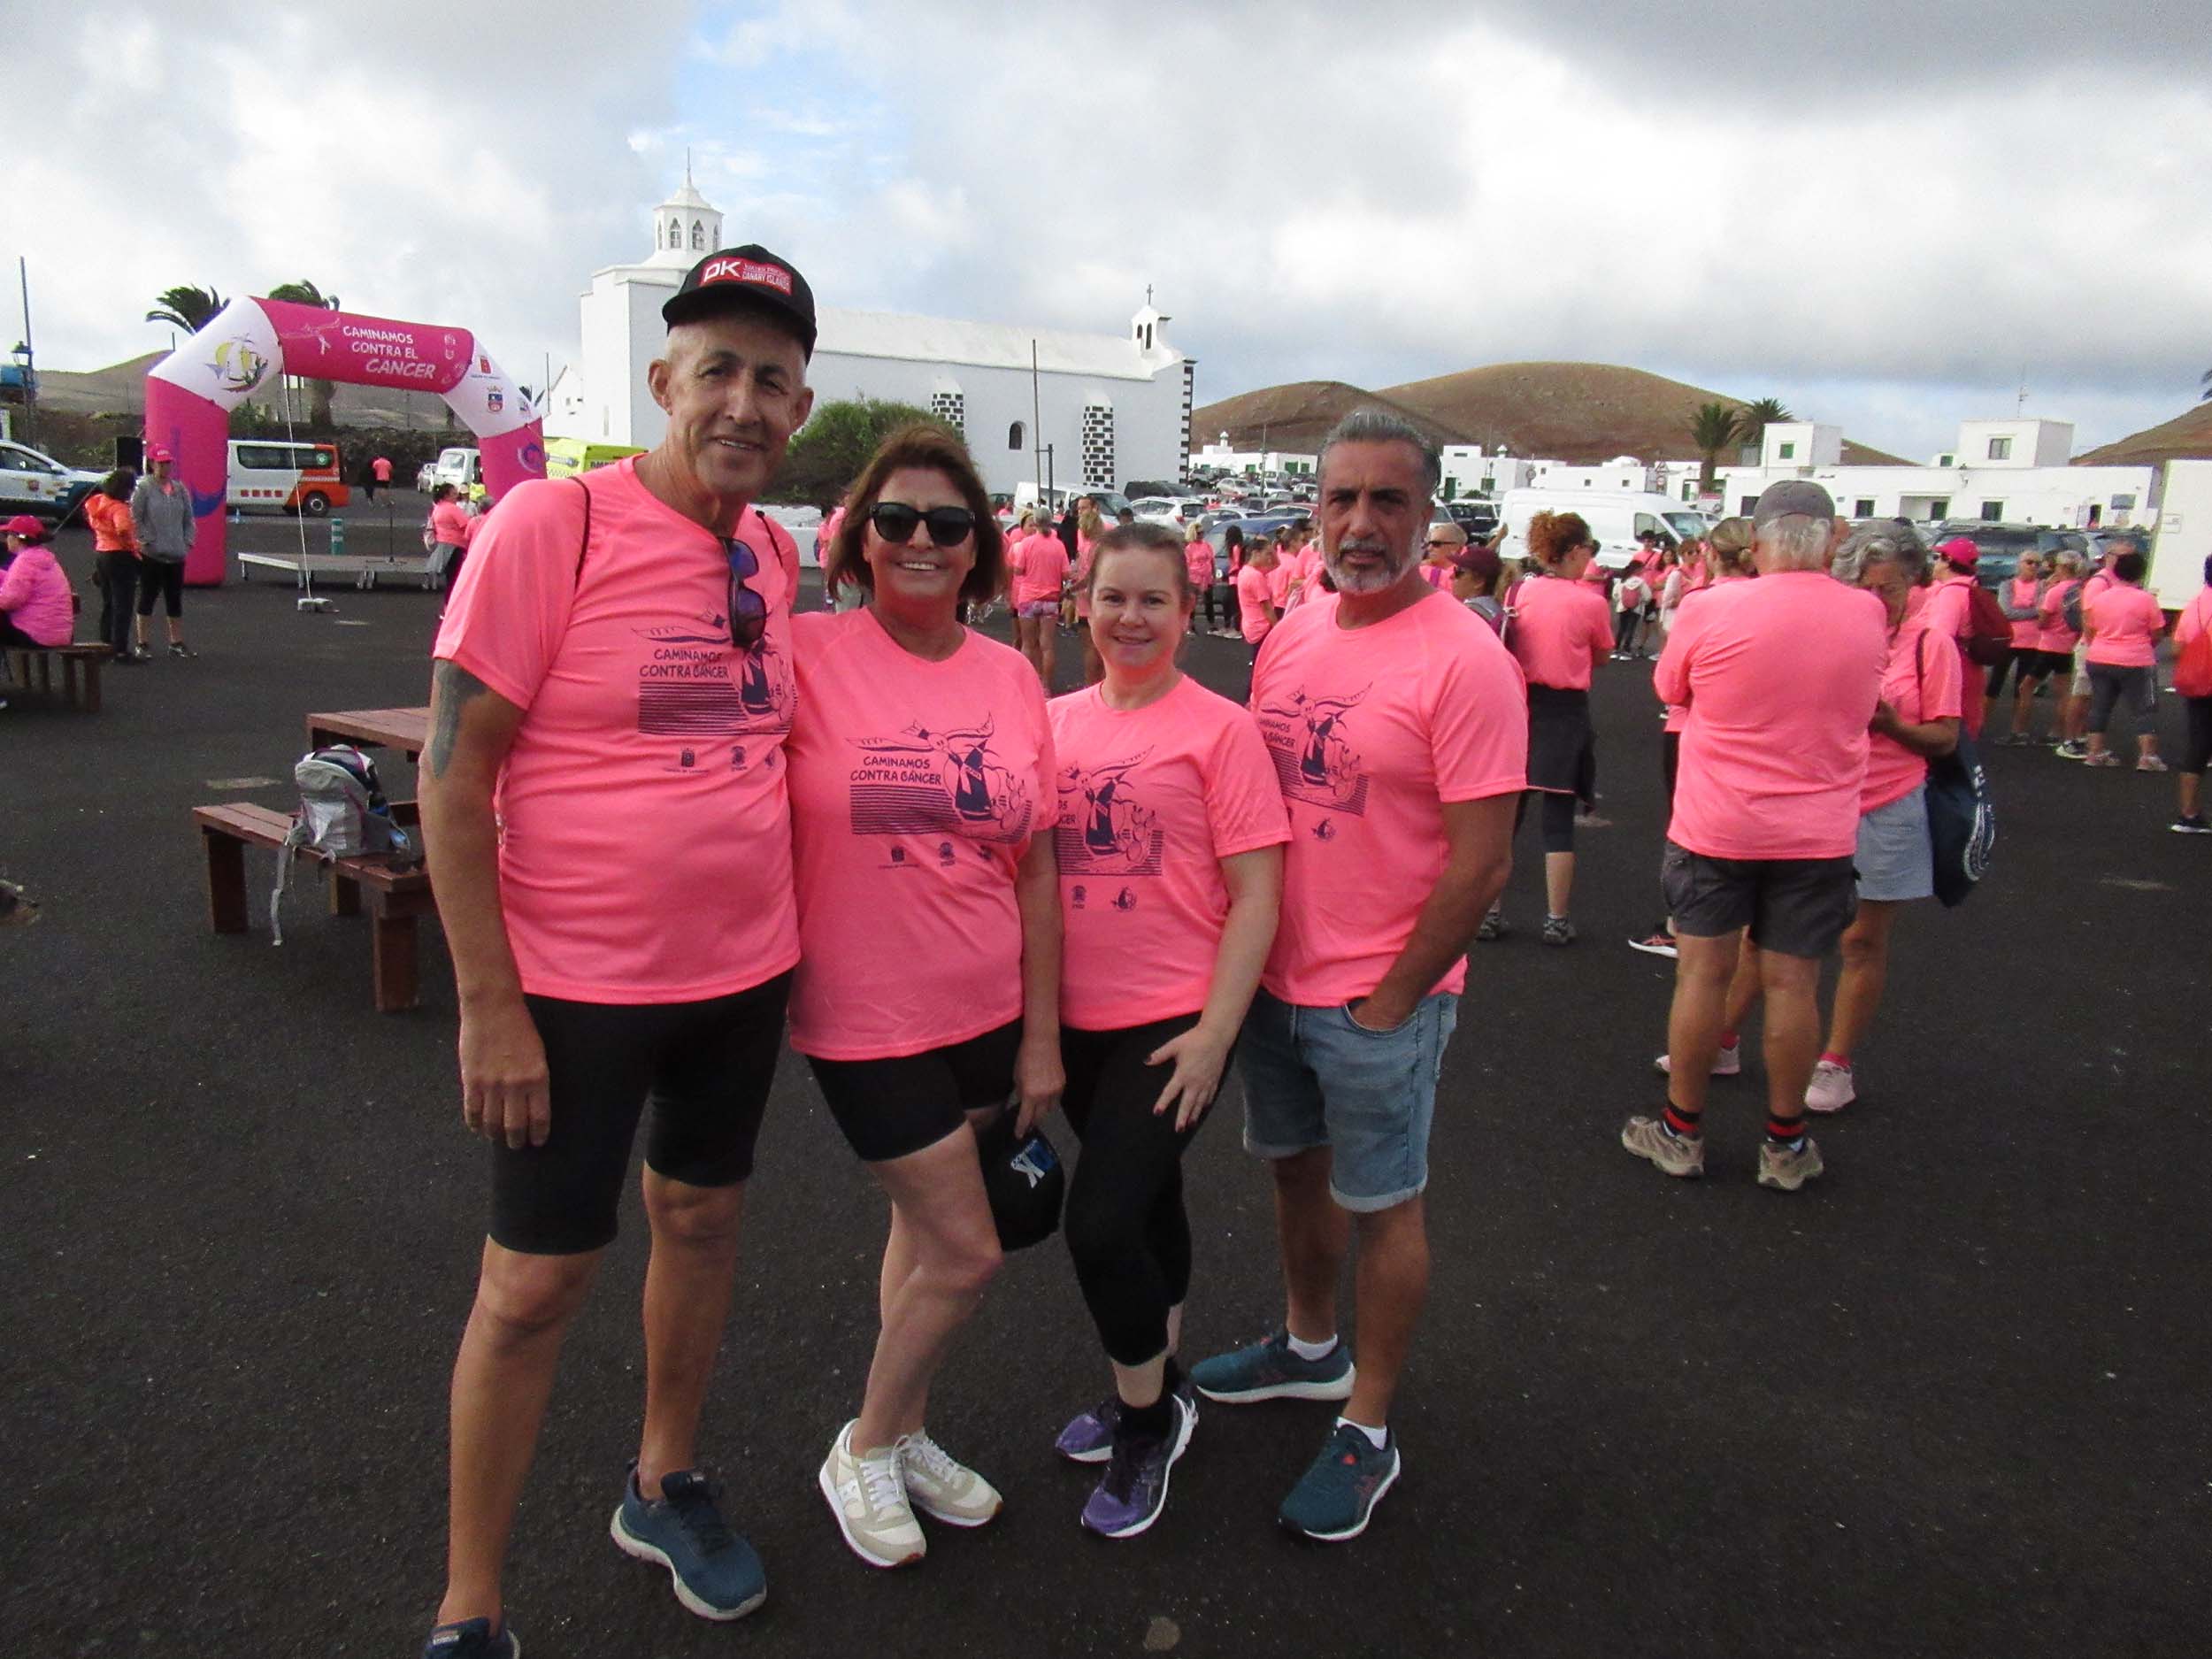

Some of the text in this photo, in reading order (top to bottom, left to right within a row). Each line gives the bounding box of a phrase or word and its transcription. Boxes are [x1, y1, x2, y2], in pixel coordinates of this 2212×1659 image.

[342, 326, 414, 344] CAMINAMOS
[351, 341, 419, 359] CONTRA EL
[365, 358, 436, 379] CANCER
[639, 664, 691, 678] CONTRA
[863, 757, 931, 770] CAMINAMOS
[849, 770, 899, 781] CONTRA
